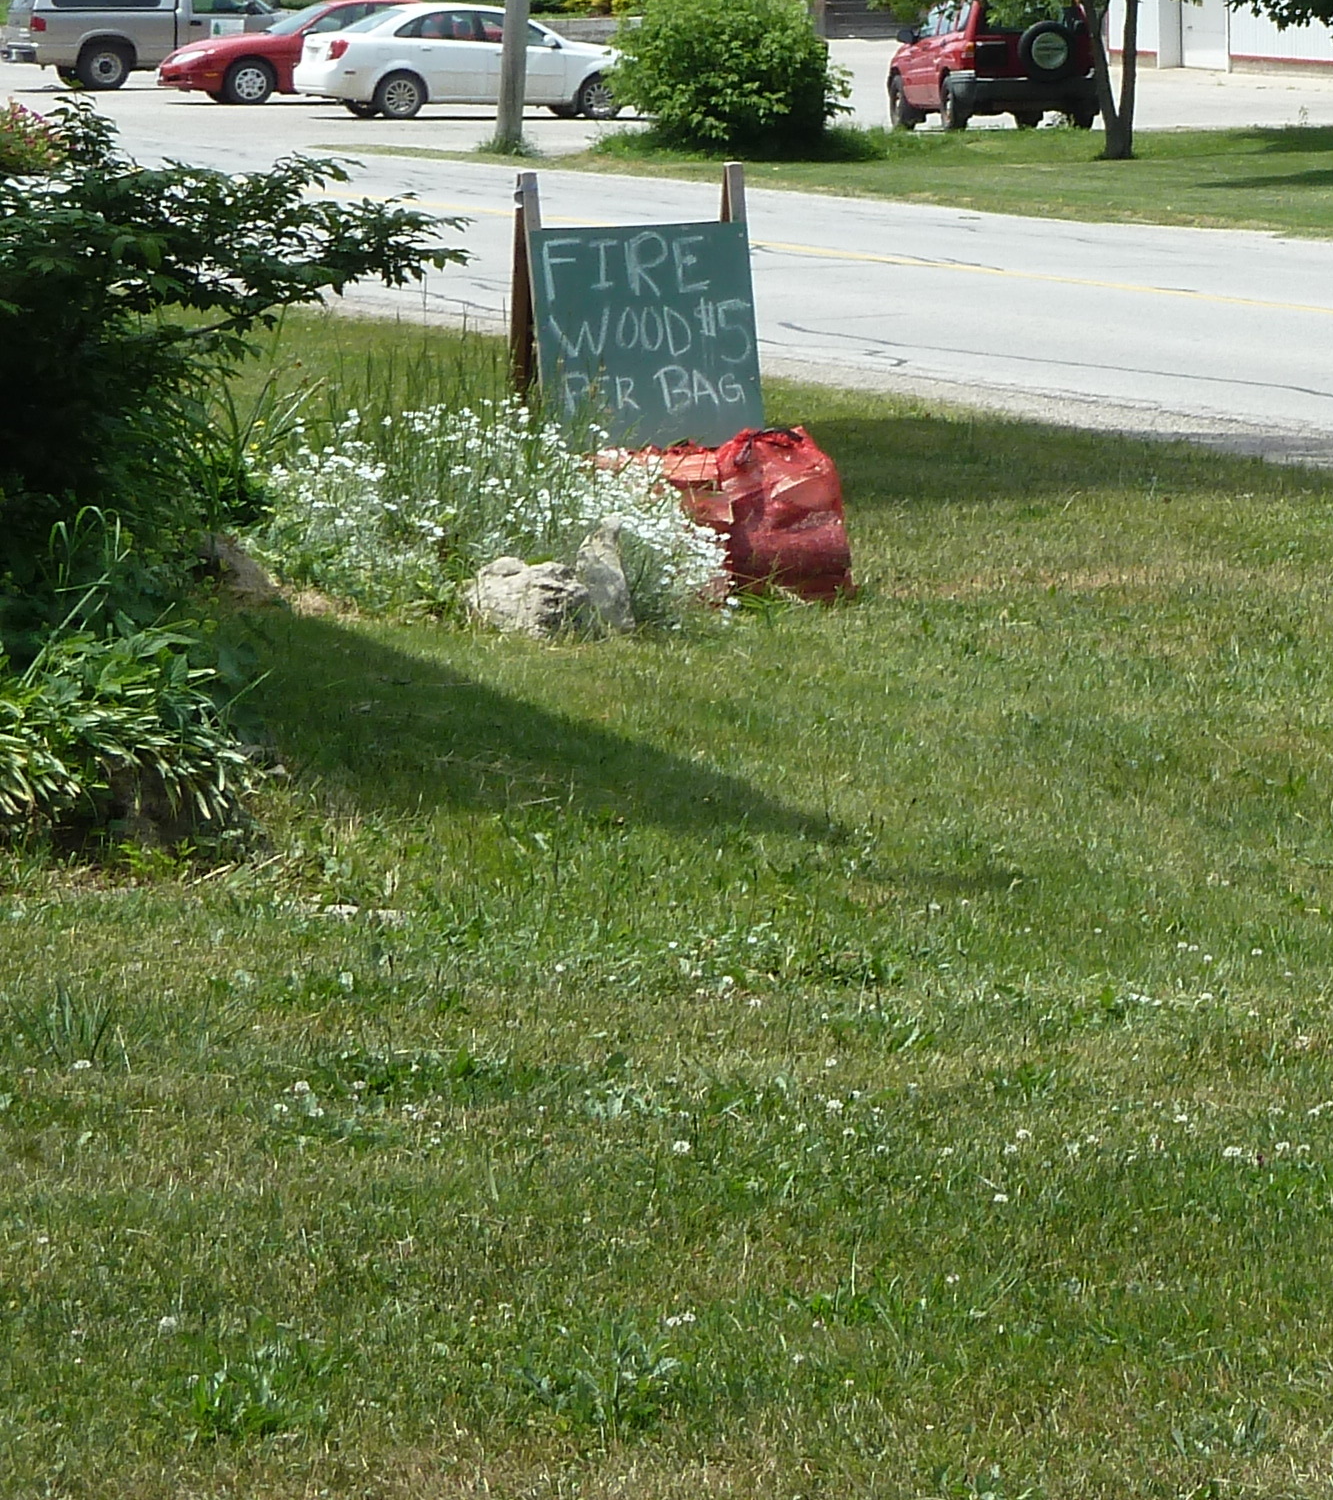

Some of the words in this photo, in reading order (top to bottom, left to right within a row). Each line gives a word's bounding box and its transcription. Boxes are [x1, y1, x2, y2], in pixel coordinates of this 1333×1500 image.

[542, 231, 710, 301] FIRE
[549, 305, 692, 357] WOOD
[653, 365, 746, 414] BAG
